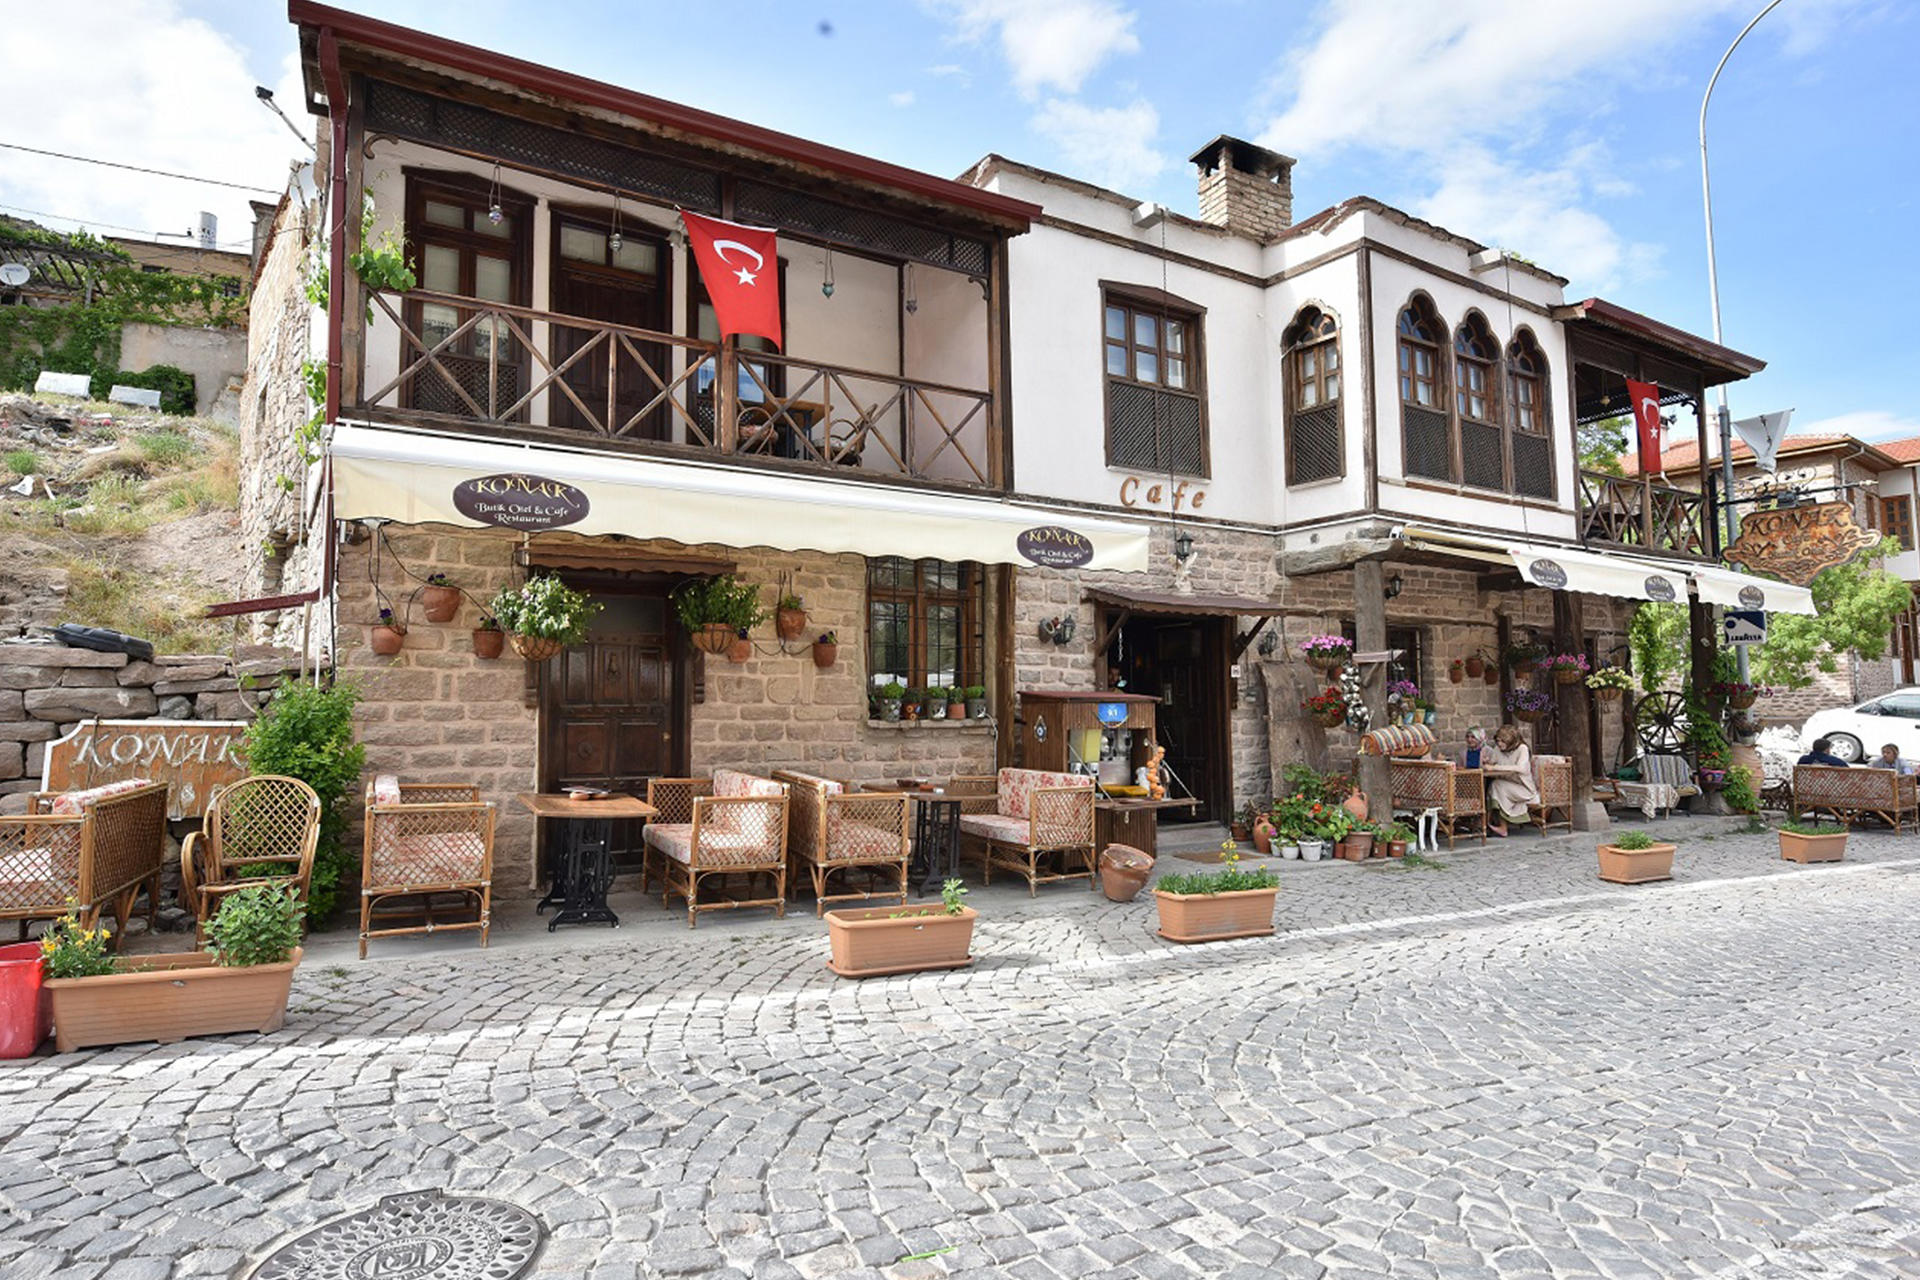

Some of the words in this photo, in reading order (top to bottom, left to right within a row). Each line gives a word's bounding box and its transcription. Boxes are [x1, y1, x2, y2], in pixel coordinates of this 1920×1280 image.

[469, 478, 580, 508] KONAK
[1120, 476, 1206, 511] Cafe
[494, 512, 552, 525] Restaurant
[534, 506, 543, 515] &
[1749, 502, 1849, 536] KONAK
[1025, 529, 1089, 554] KONAK
[70, 733, 250, 769] KONAK
